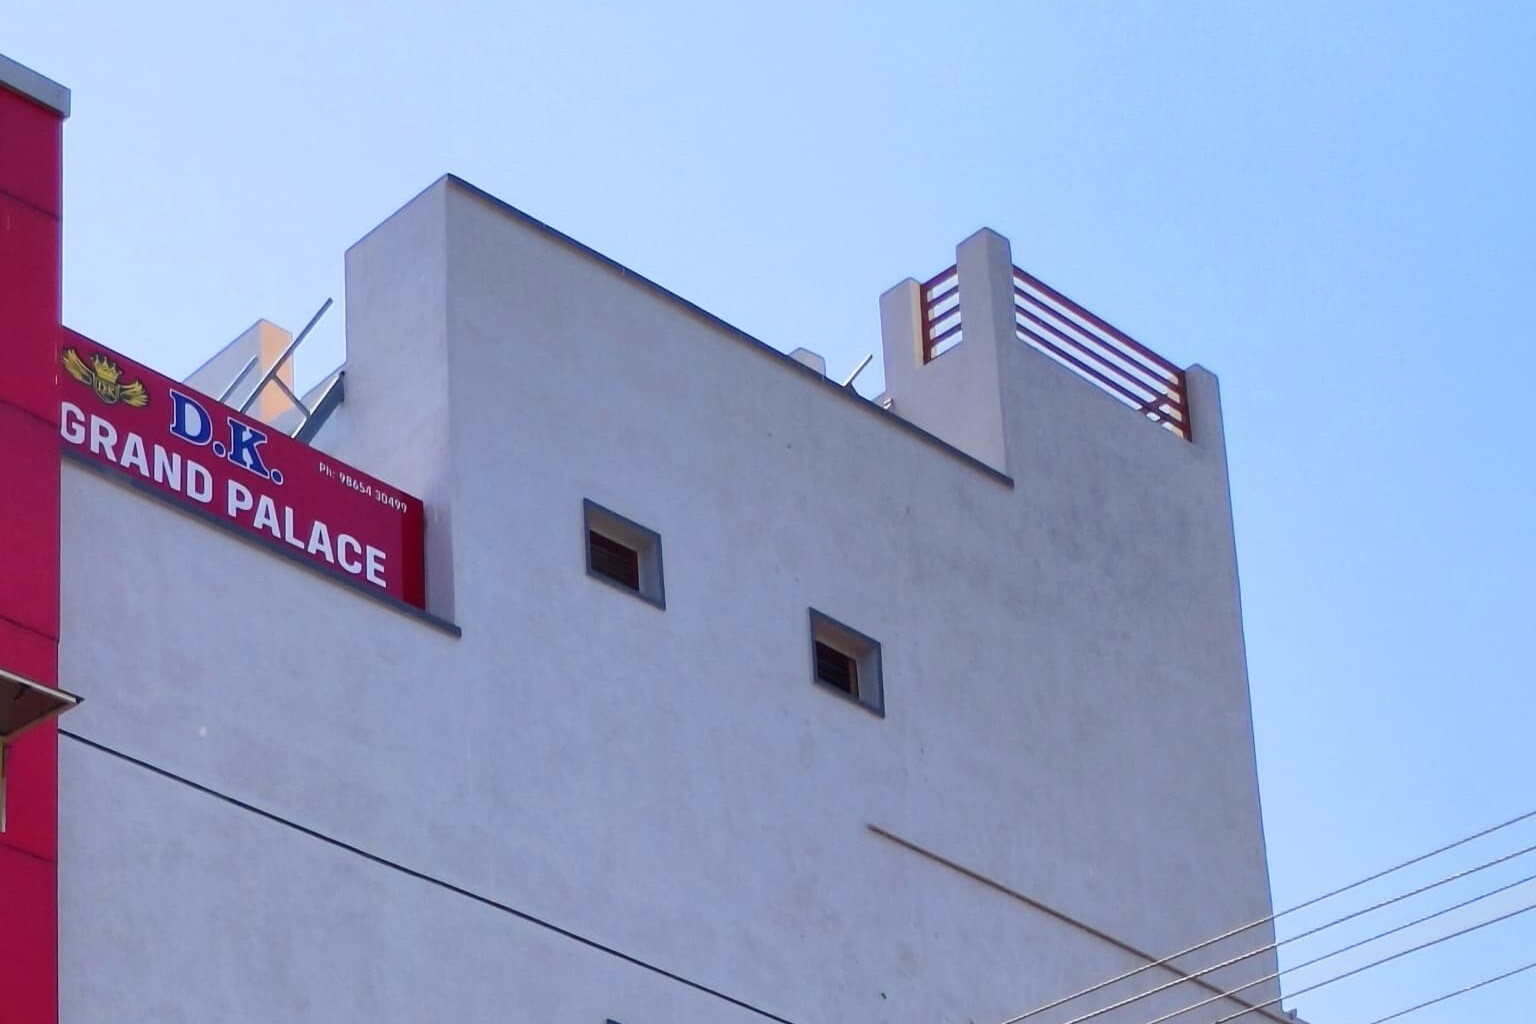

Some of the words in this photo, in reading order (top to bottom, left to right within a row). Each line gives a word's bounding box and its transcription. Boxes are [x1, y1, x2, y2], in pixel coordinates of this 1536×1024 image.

[169, 389, 284, 485] D.K.
[339, 472, 373, 496] 98654
[61, 401, 213, 504] GRAND
[227, 479, 388, 588] PALACE
